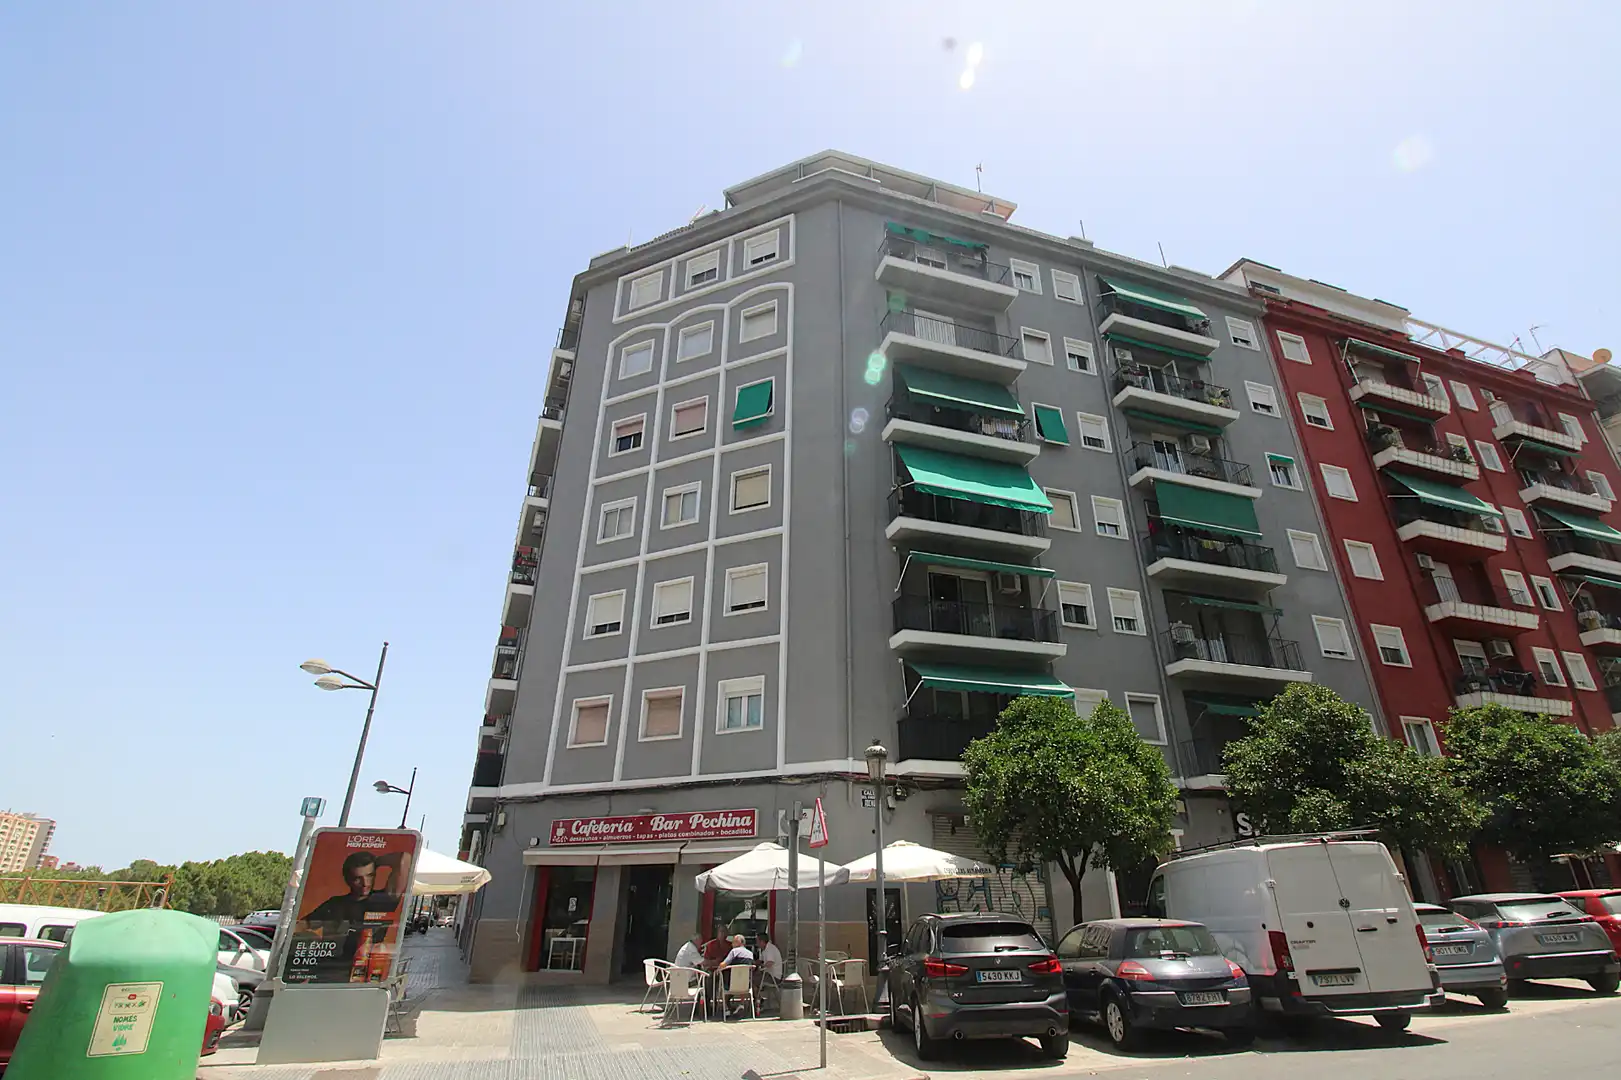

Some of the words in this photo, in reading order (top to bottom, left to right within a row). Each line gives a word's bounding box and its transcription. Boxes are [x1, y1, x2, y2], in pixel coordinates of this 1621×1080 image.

[571, 820, 634, 837] Cafetería
[650, 816, 683, 831] Bar
[689, 813, 752, 829] Pechina
[296, 942, 308, 950] EL
[309, 940, 337, 950] ÉXITO
[982, 971, 1003, 980] 5430
[1004, 970, 1019, 980] KKJ
[113, 1015, 138, 1023] NOMÉS
